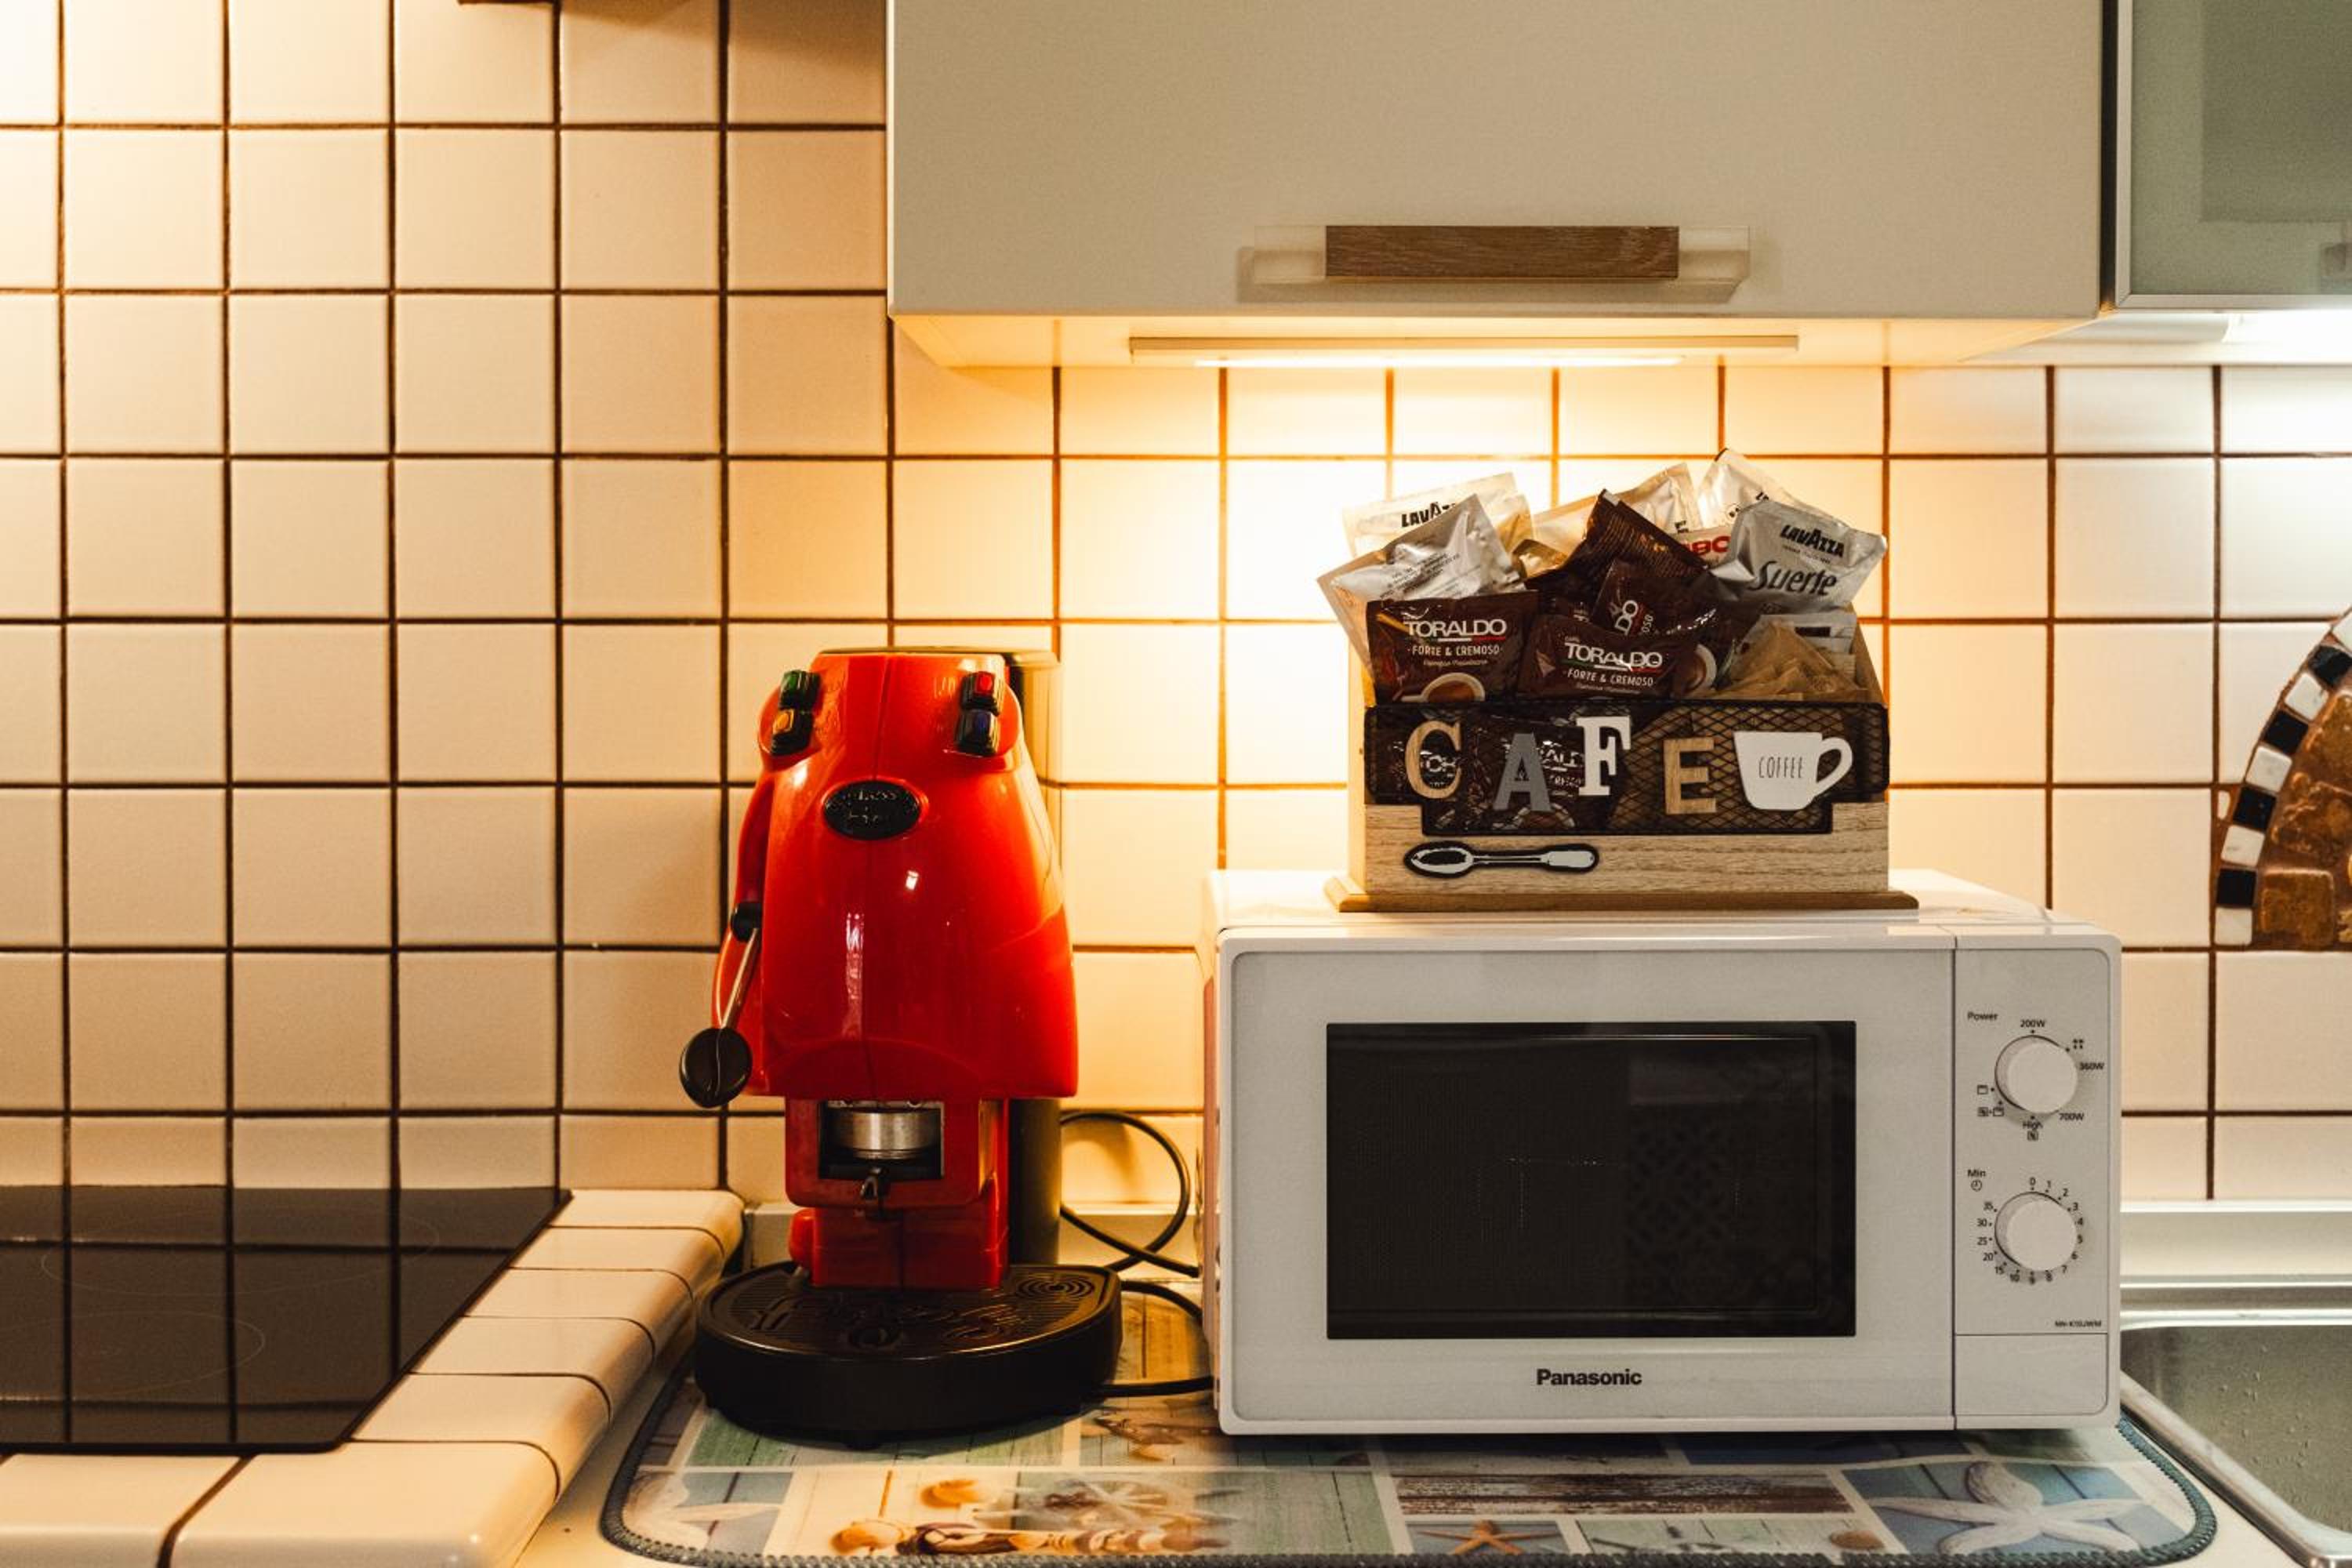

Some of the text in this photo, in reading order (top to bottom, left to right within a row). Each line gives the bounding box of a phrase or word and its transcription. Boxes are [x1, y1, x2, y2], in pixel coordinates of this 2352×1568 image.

[1780, 524, 1845, 557] LAVAZZA
[1748, 560, 1838, 596] Suerte
[1403, 619, 1508, 637] TORALDO
[1412, 644, 1500, 656] FORTE & CREMOSO
[1564, 642, 1663, 668] TORALDO
[1567, 668, 1654, 688] FORTE & CREMOSO
[1758, 756, 1804, 779] COFFEE
[1967, 1011, 1998, 1021] Power
[2020, 1019, 2045, 1028] 200W
[2079, 1062, 2105, 1071] 360W
[2059, 1112, 2085, 1121] 700W
[2022, 1120, 2043, 1131] High
[1967, 1169, 1987, 1178] Min
[2029, 1177, 2036, 1186] 0
[2046, 1180, 2052, 1189] 1
[2063, 1189, 2069, 1197] 2
[2072, 1203, 2078, 1211] 3
[1976, 1219, 1987, 1228] 30
[1977, 1237, 1987, 1246] 25
[1983, 1253, 1994, 1261] 20
[1994, 1266, 2005, 1275] 15
[2061, 1265, 2067, 1273] 7
[2009, 1273, 2020, 1283] 10
[1536, 1368, 1642, 1386] Panasonic
